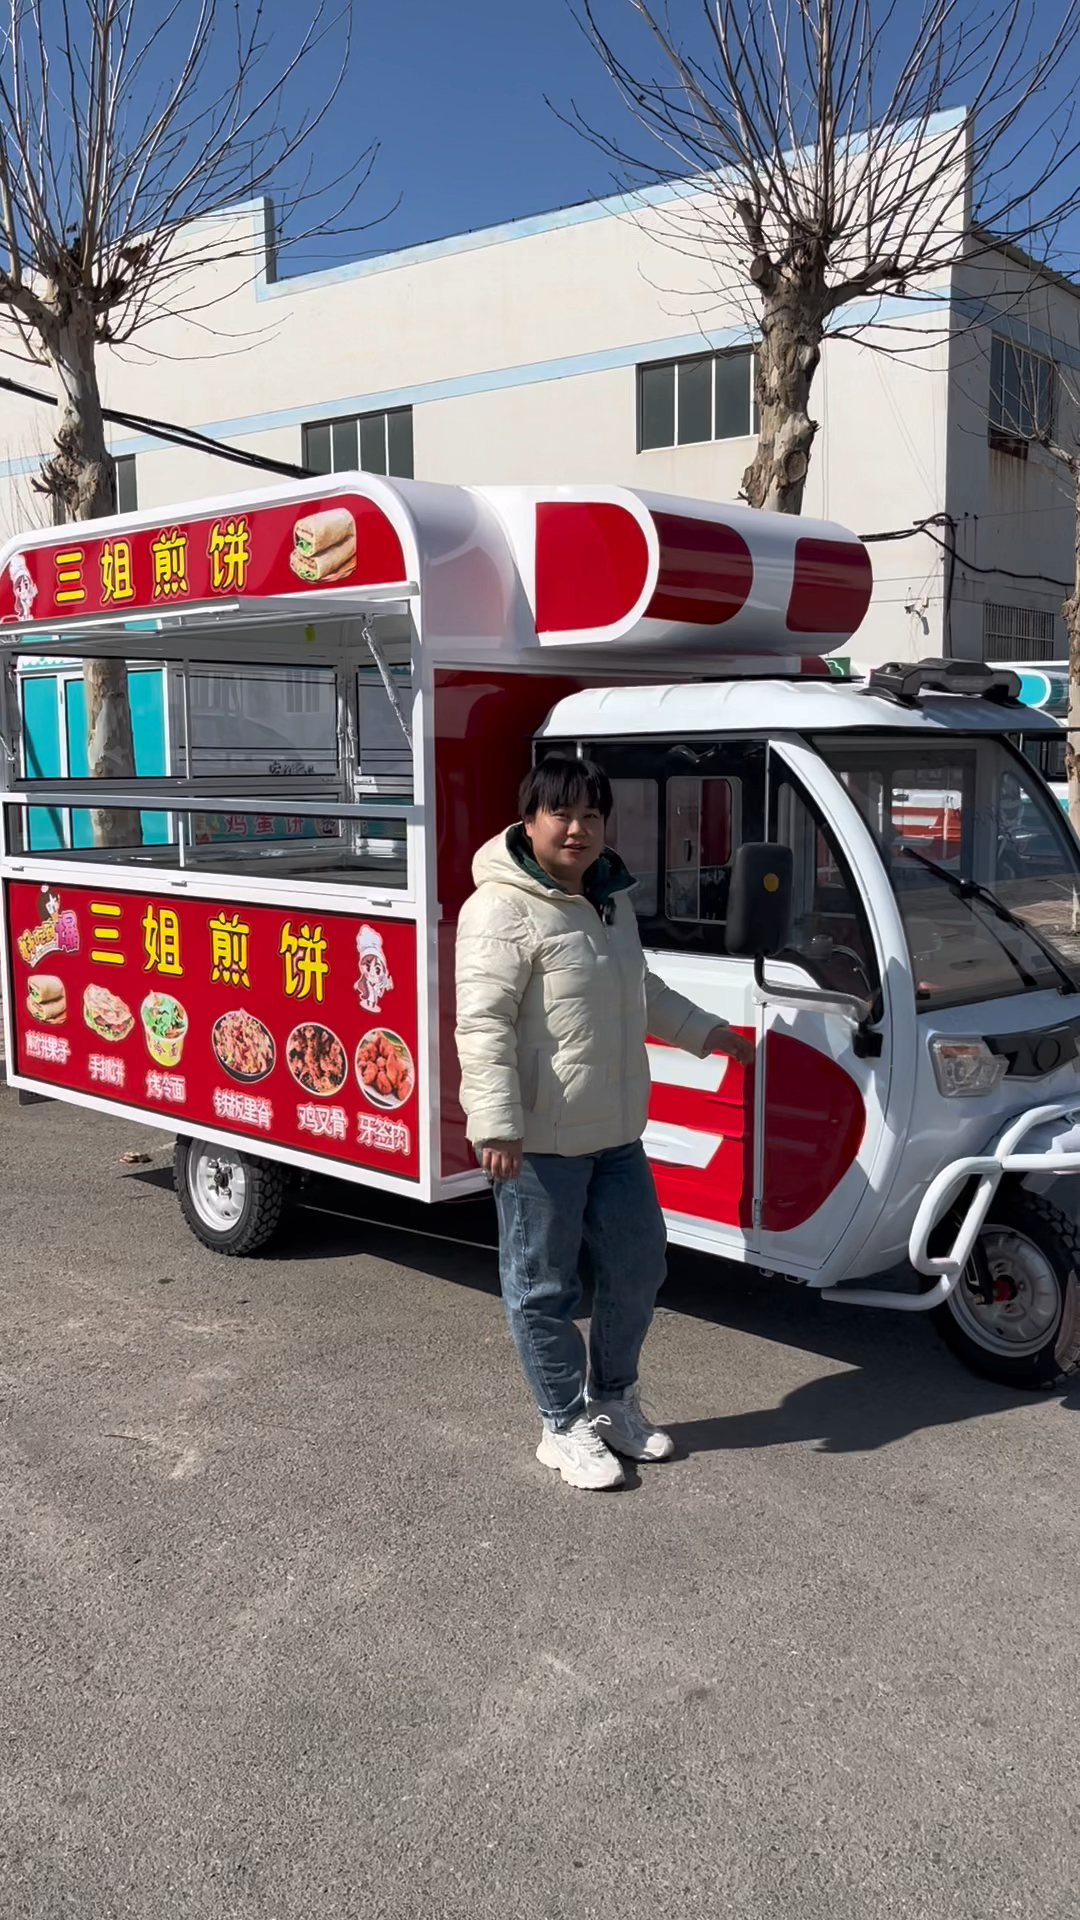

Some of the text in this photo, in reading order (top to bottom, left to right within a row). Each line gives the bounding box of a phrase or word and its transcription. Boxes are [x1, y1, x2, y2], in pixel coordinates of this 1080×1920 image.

[54, 516, 250, 603] 三姐煎饼
[88, 901, 330, 1002] 三姐煎饼
[25, 1030, 71, 1064] 煎饼果子
[89, 1054, 125, 1087] 手抓饼
[146, 1070, 187, 1103] 烤冷面
[214, 1087, 273, 1131] 铁板里脊
[297, 1103, 348, 1140] 鸡叉骨
[357, 1112, 410, 1155] 牙签肉
